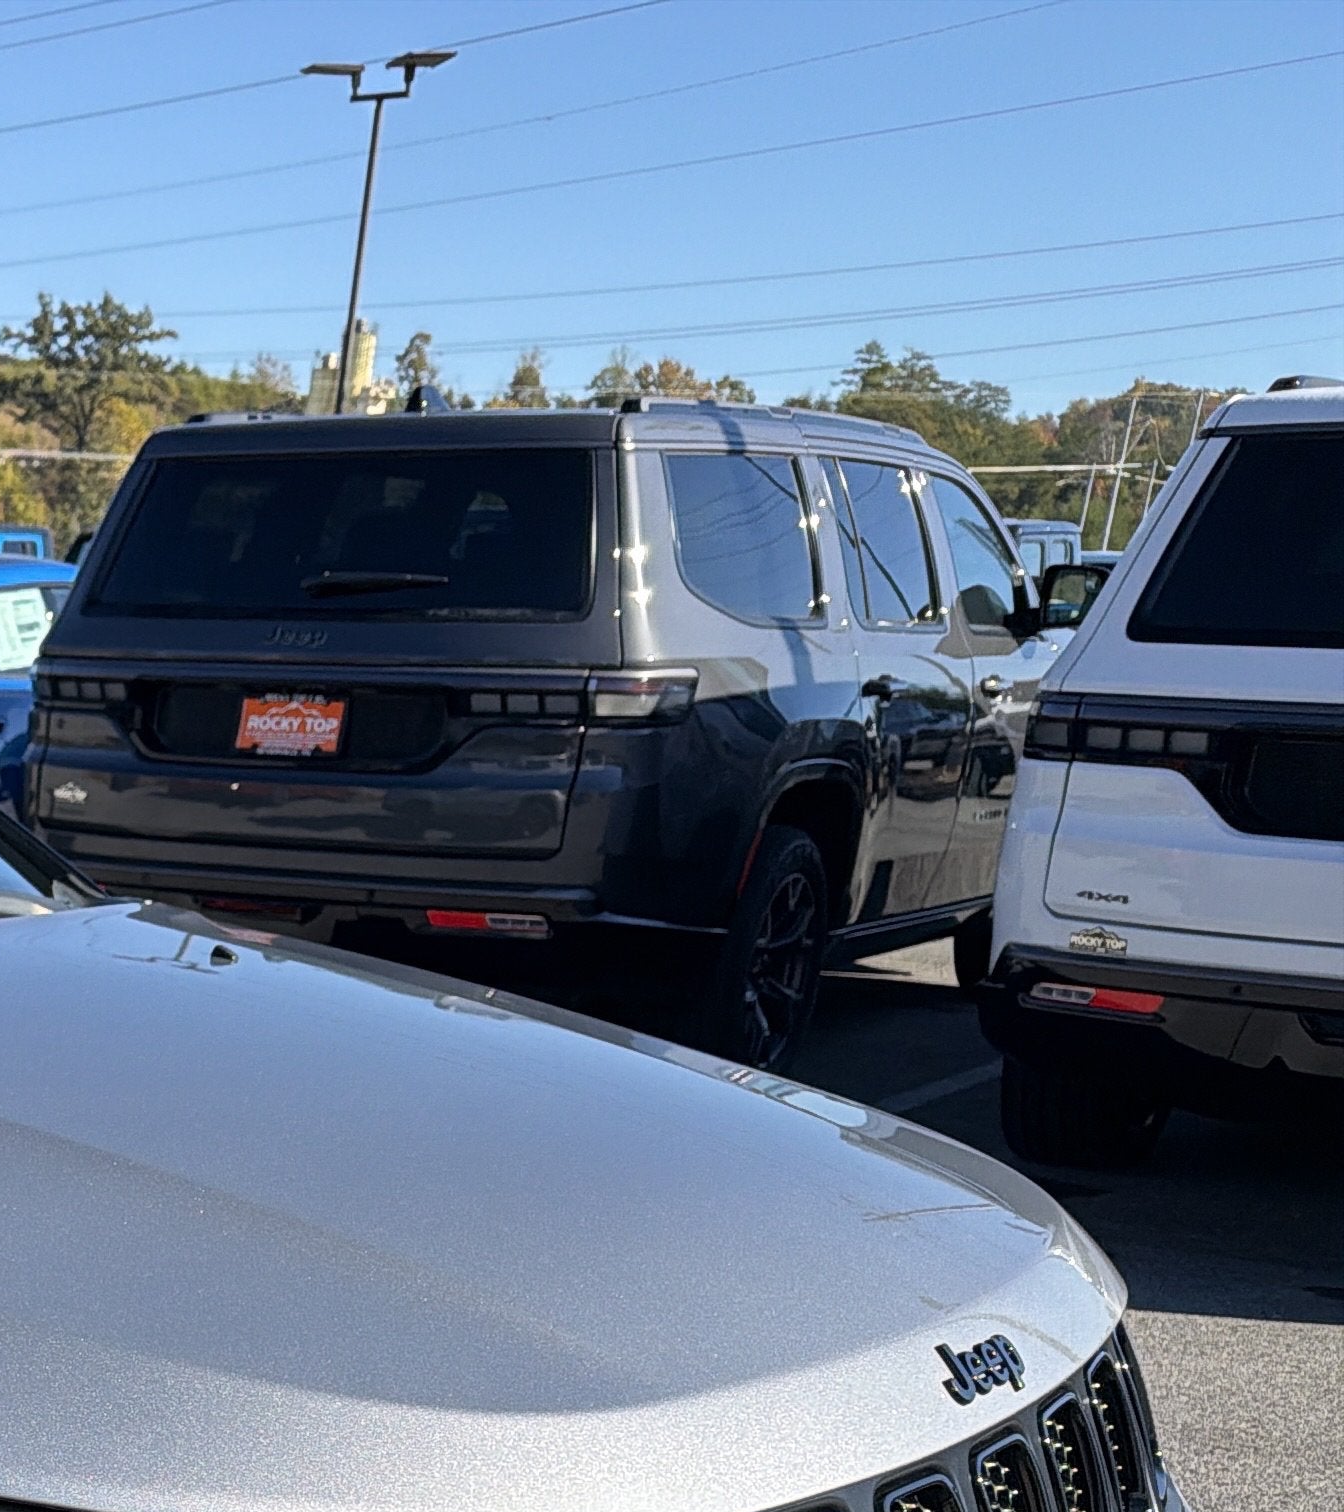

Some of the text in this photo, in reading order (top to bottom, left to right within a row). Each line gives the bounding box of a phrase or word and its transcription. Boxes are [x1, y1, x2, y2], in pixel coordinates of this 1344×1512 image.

[263, 623, 329, 648] Jeep
[246, 714, 339, 733] ROCKY TOP
[1070, 935, 1127, 950] ROCKY TOP
[934, 1334, 1025, 1406] Jeep
